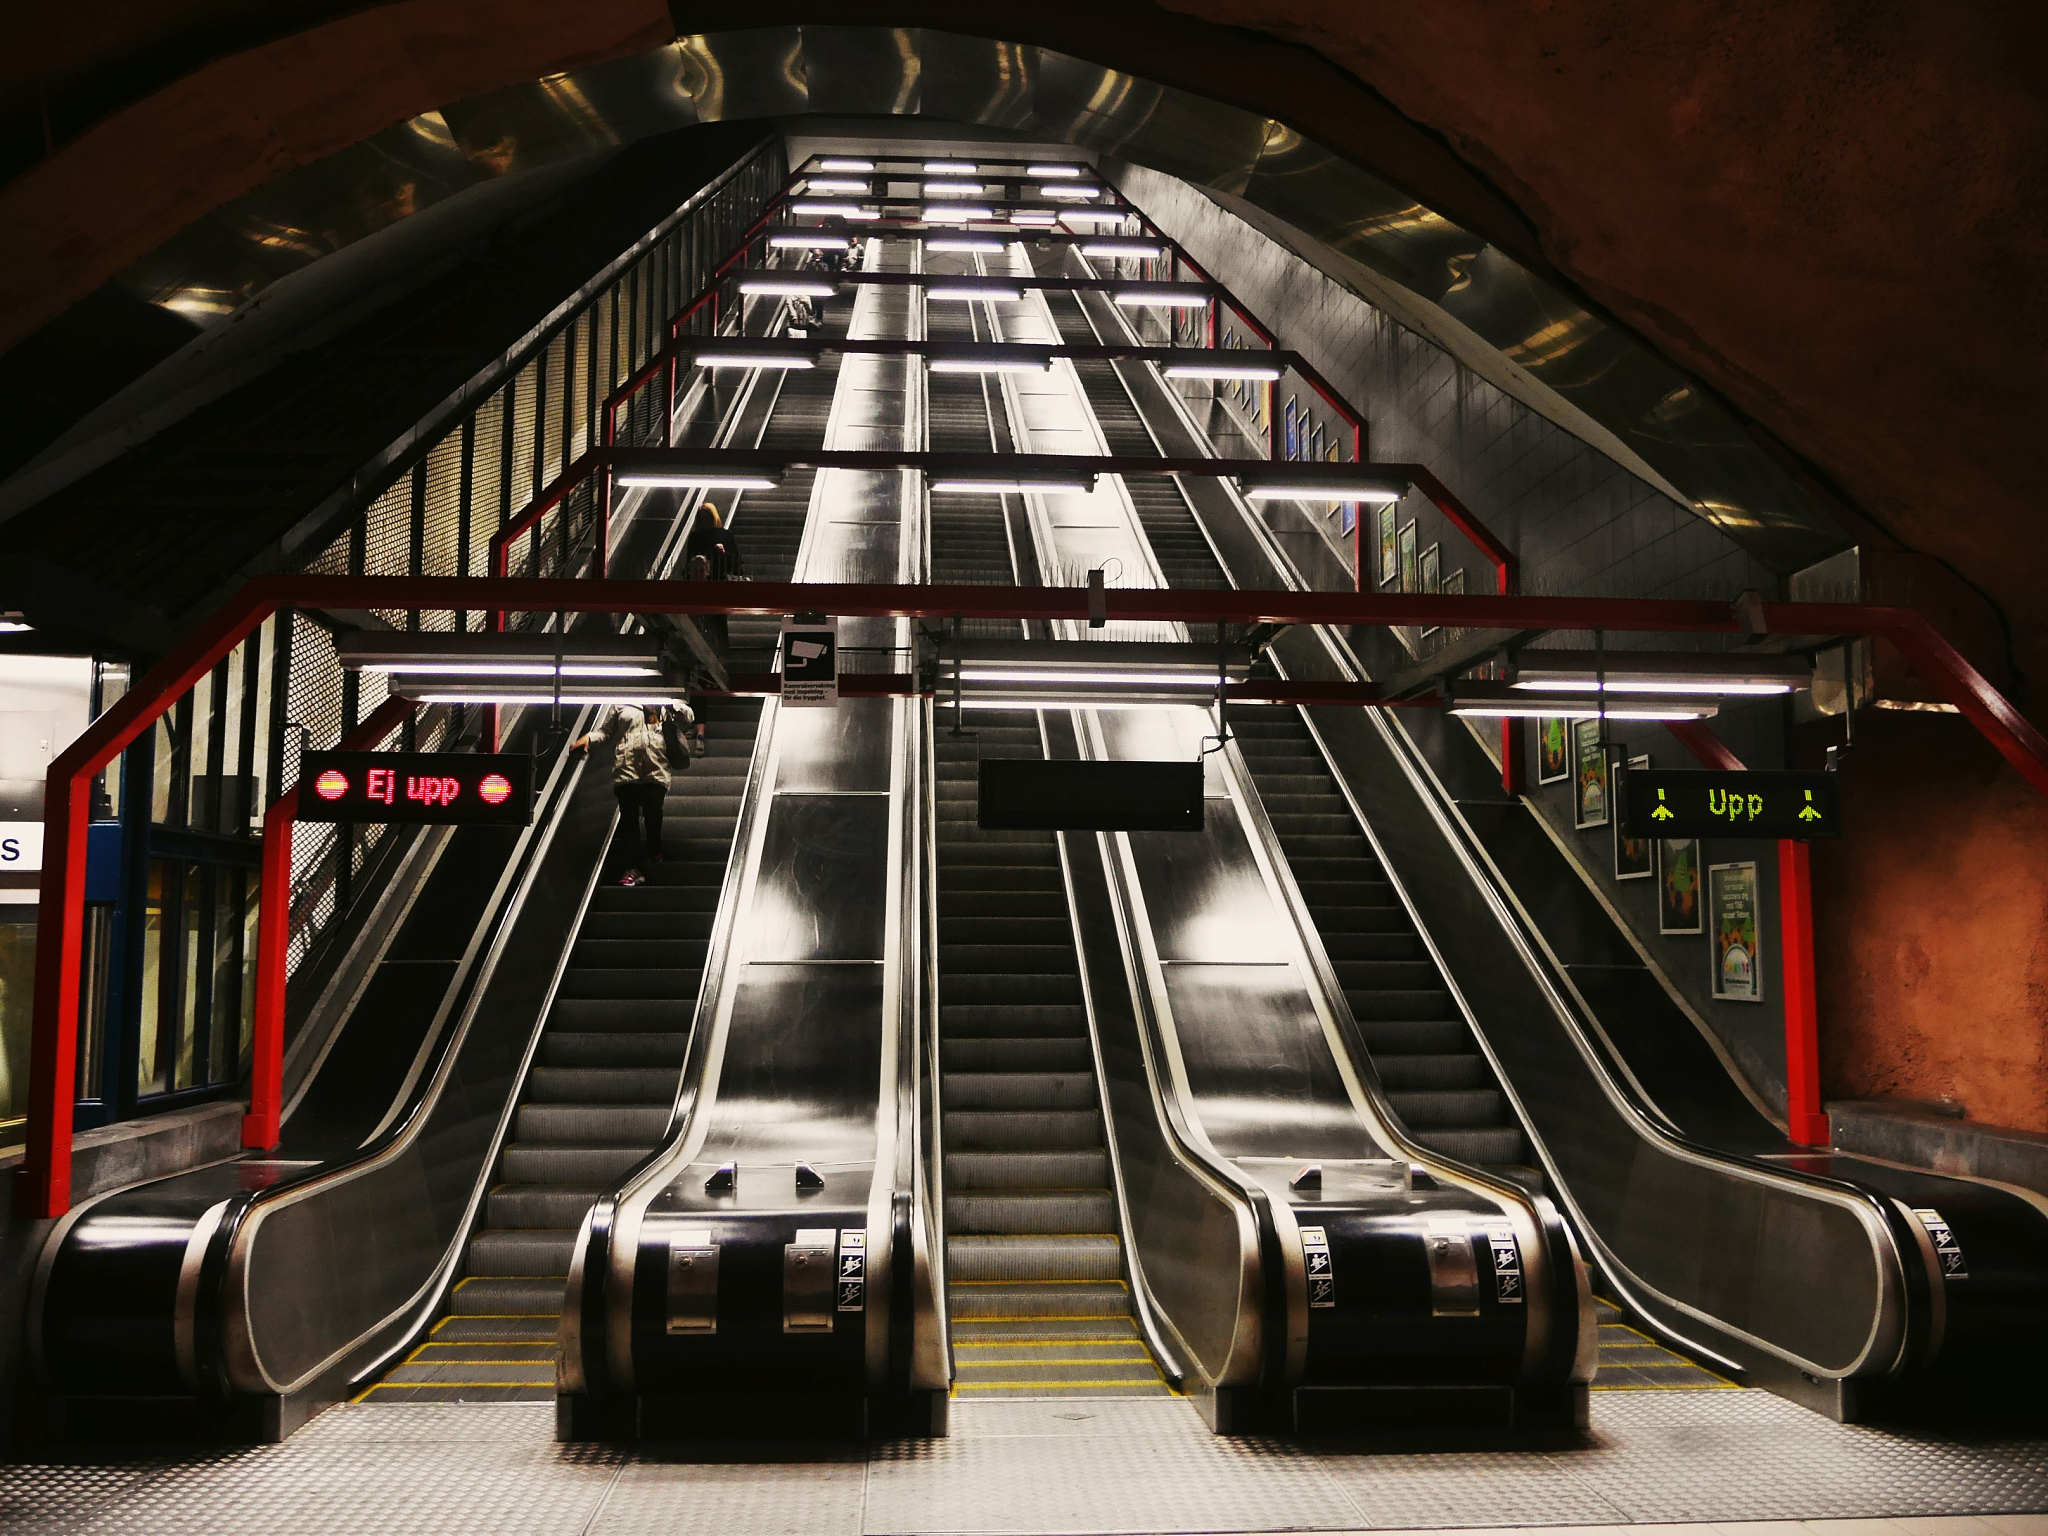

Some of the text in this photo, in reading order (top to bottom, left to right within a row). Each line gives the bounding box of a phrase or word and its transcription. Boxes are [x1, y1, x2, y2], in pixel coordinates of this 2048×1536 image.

[366, 769, 460, 806] Ej upp
[1709, 788, 1763, 821] Upp
